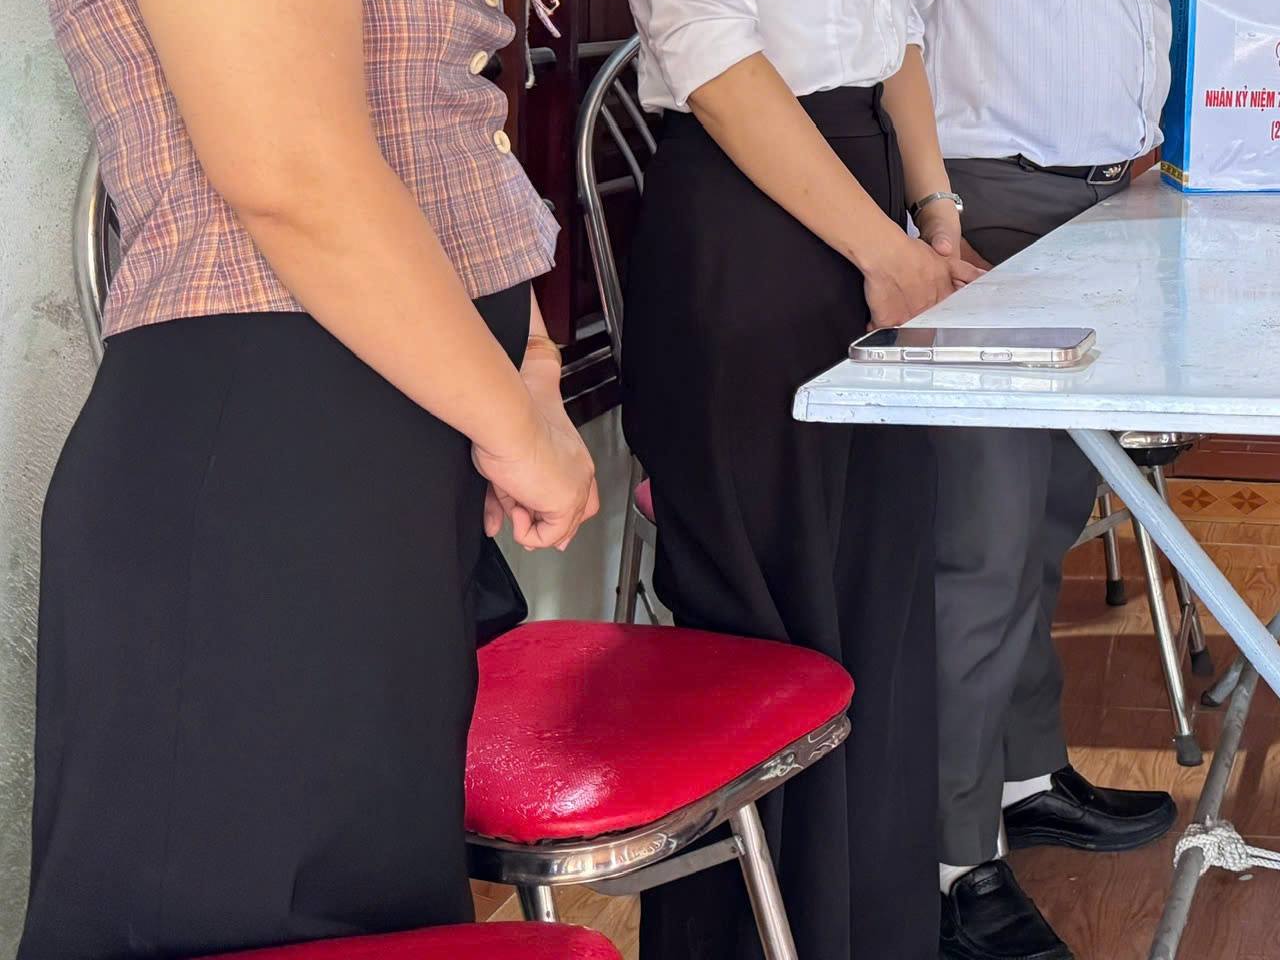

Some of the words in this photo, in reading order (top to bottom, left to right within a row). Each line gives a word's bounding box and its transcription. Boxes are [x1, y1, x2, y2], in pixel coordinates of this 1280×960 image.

[1205, 87, 1233, 108] NHÂN
[1235, 85, 1248, 107] KỶ
[1250, 87, 1275, 111] NIỆM
